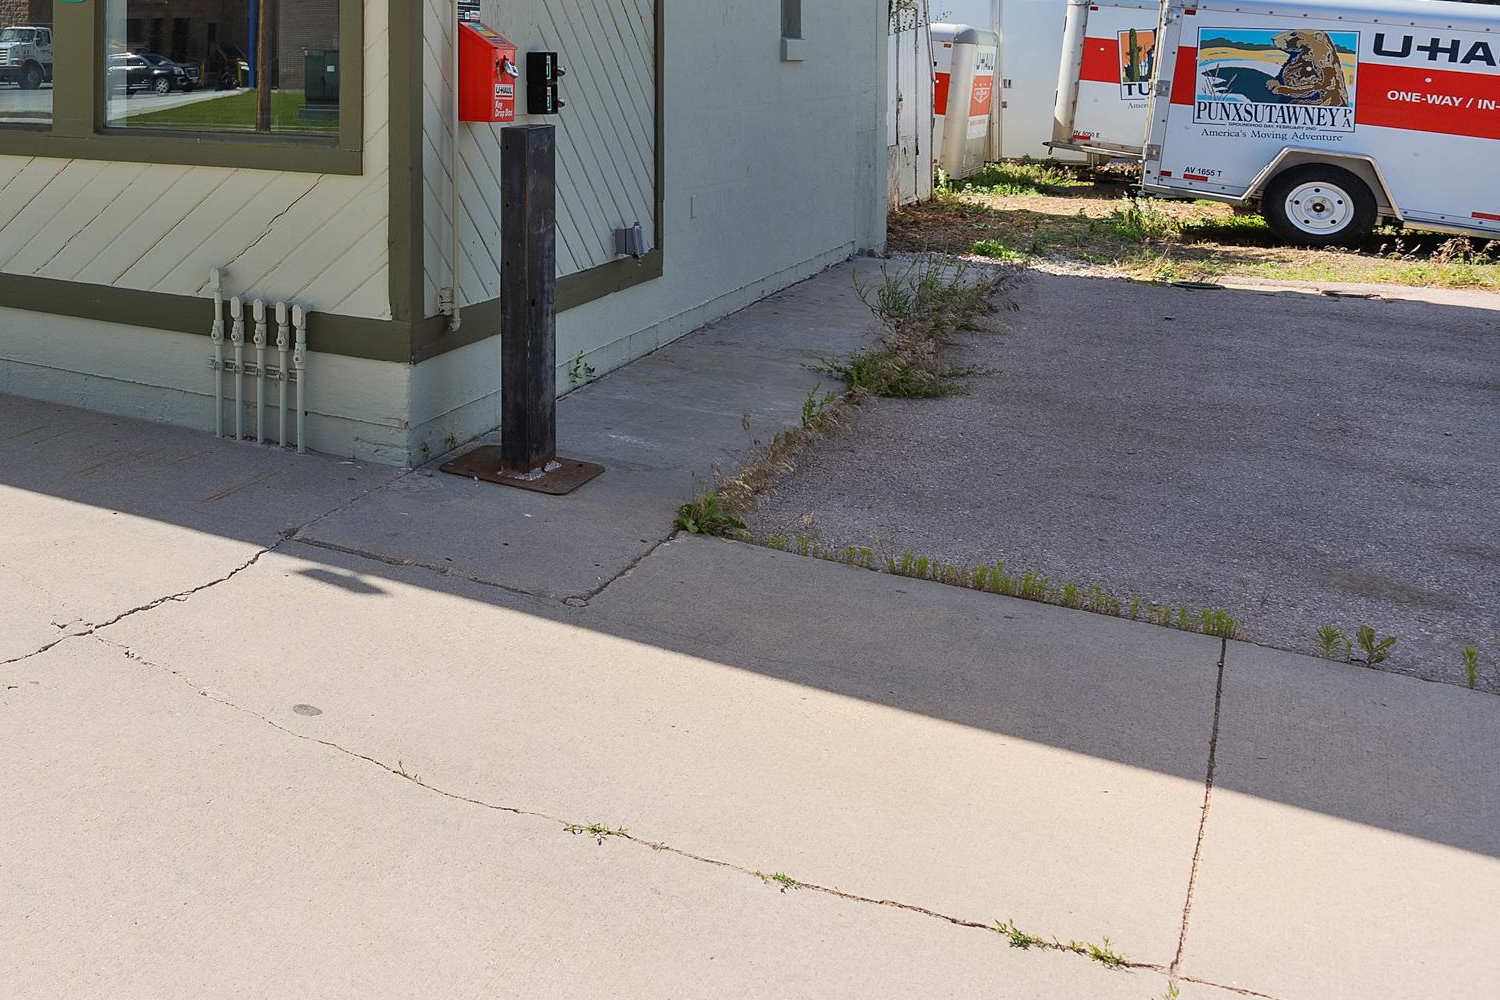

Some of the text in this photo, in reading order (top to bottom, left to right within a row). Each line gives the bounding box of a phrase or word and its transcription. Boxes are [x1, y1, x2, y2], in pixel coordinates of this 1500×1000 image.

[1373, 33, 1500, 67] U-HA
[1387, 90, 1463, 107] ONE-WAY
[1196, 101, 1341, 128] PUNXSUTAWNEY
[1201, 128, 1344, 142] America's Moving Adventure
[1184, 166, 1223, 178] AV 1655 T
